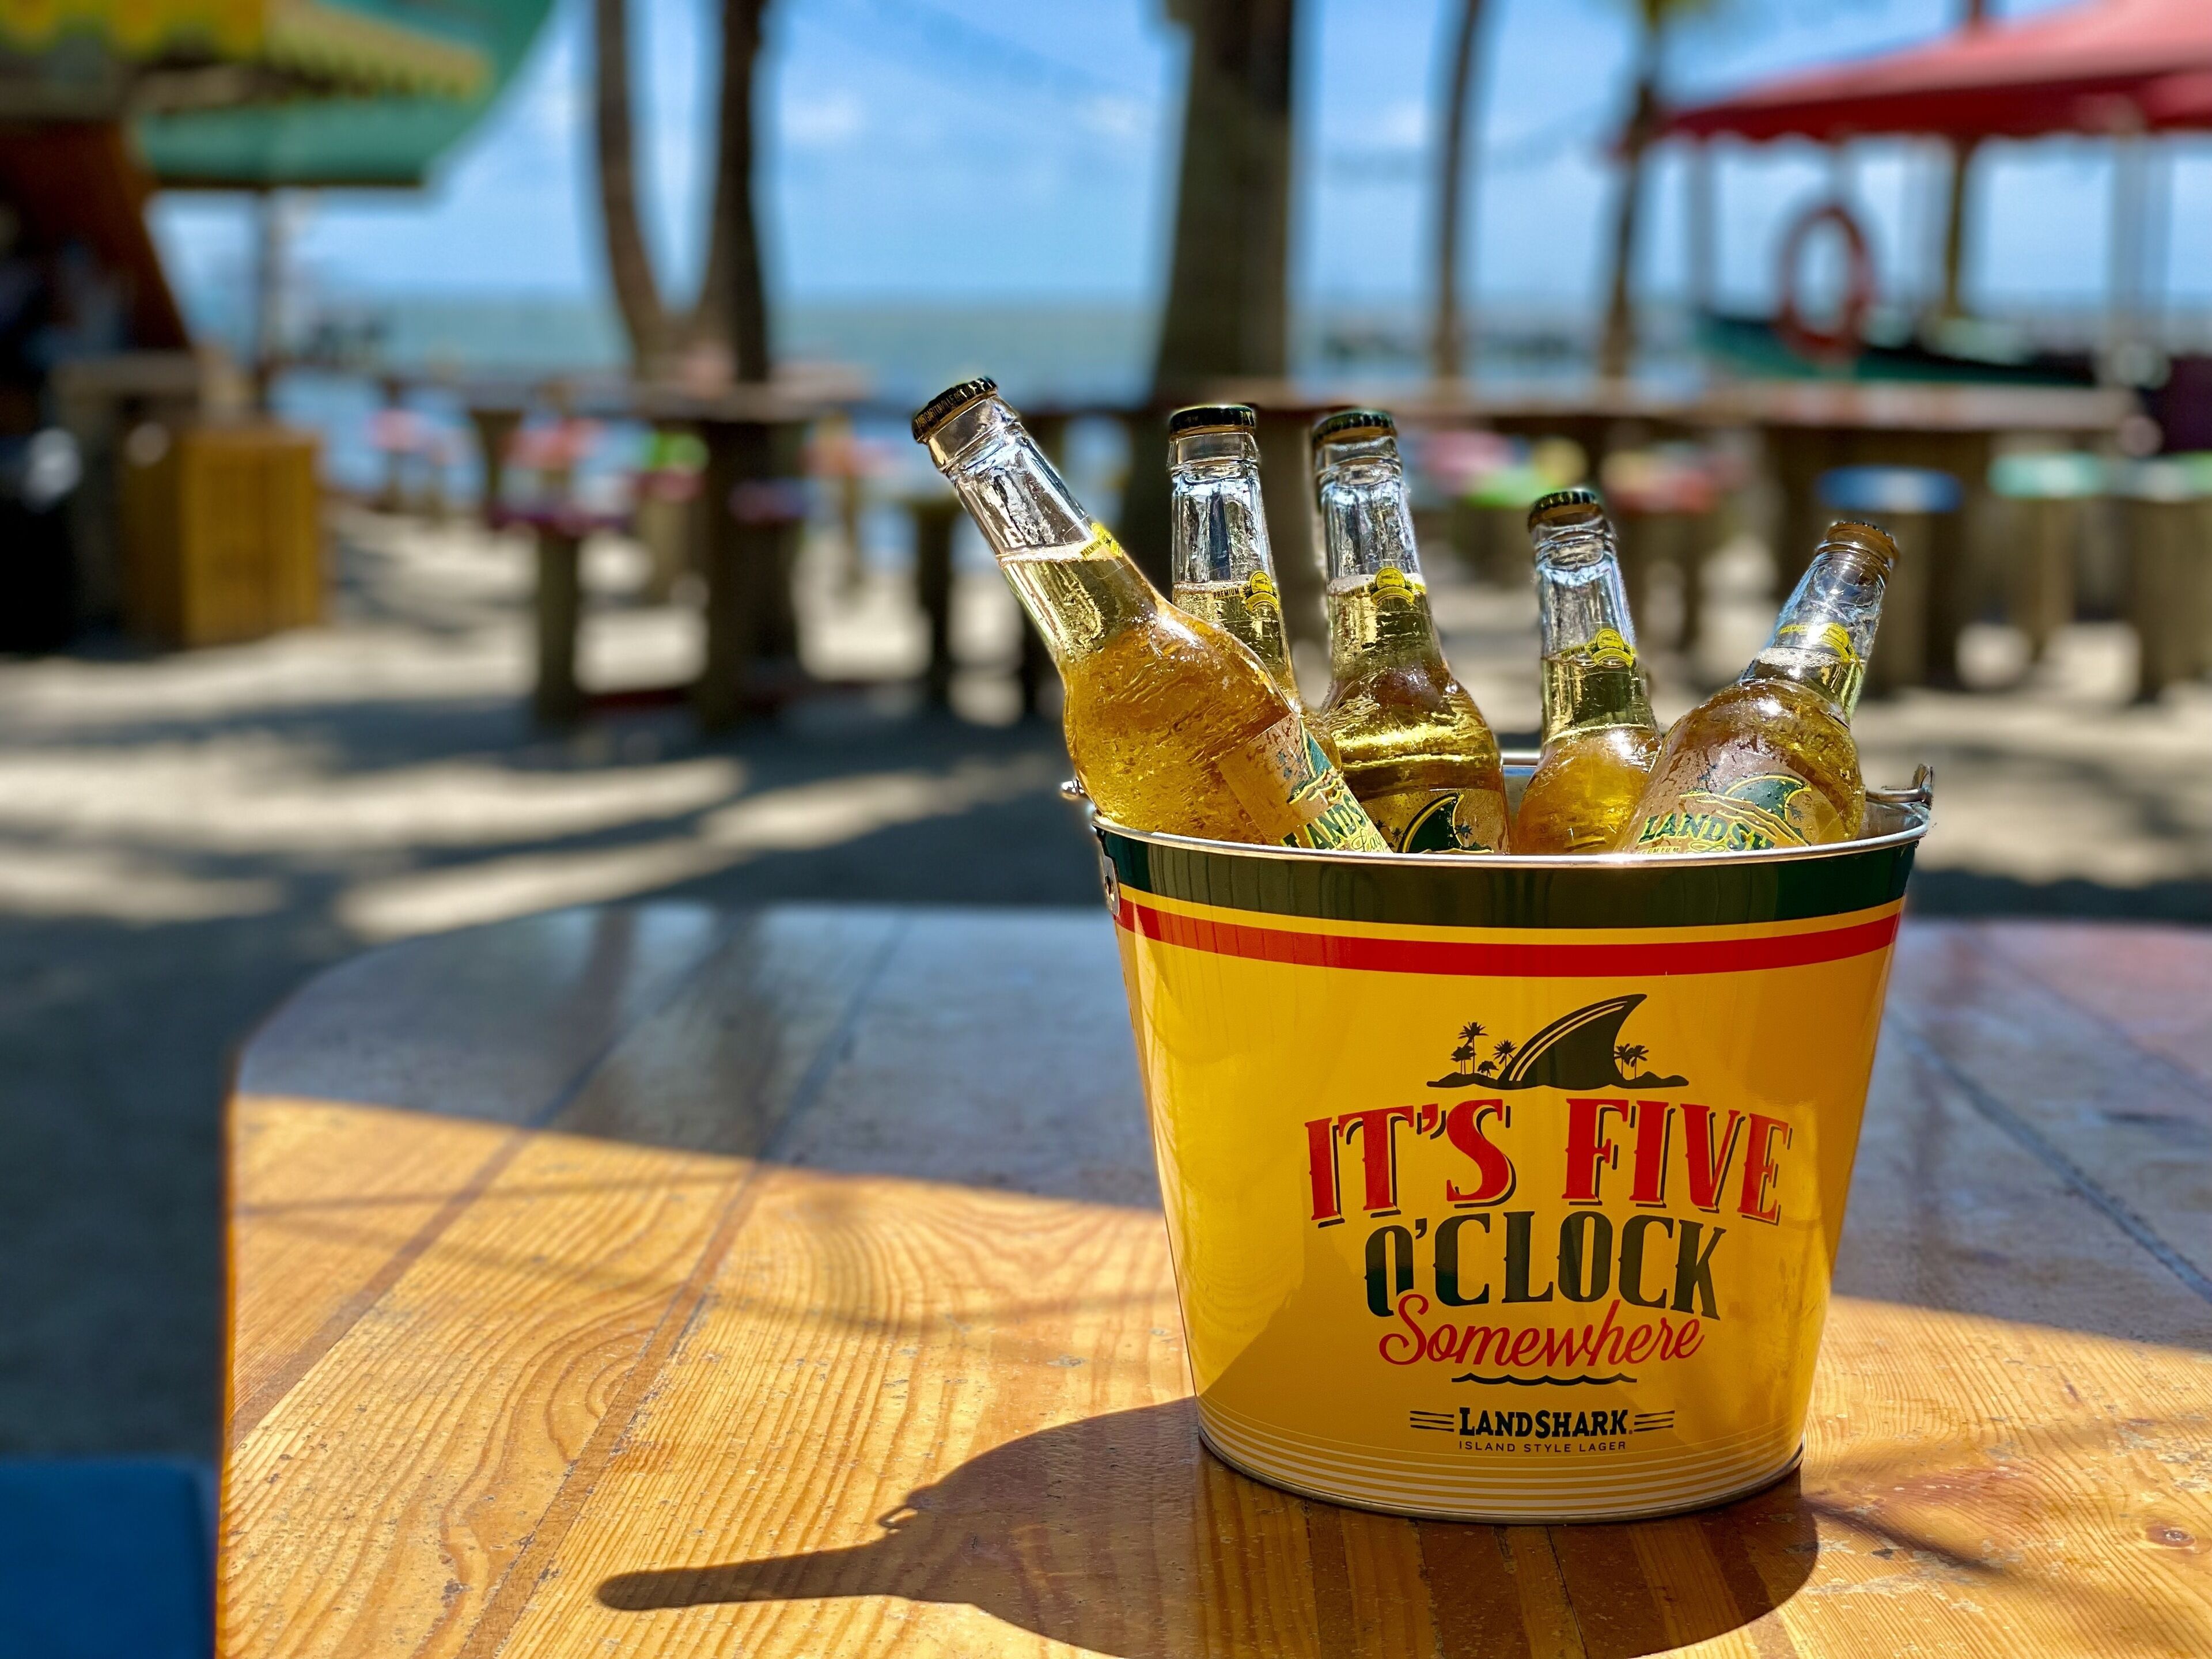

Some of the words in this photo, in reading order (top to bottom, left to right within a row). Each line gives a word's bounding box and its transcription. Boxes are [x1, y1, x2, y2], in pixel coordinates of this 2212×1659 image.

[1080, 539, 1103, 558] PREMIUM
[1213, 588, 1240, 599] PREMIUM
[1343, 586, 1365, 600] PREMIUM
[1561, 646, 1585, 658] PREMIUM
[1304, 1099, 1517, 1228] IT'S
[1561, 1097, 1793, 1226] FIVE
[1364, 1210, 1727, 1320] O'CLOCK
[1379, 1294, 1705, 1368] Somewhere
[1459, 1440, 1516, 1452] ISLAND
[1524, 1444, 1571, 1453] STYLE
[1579, 1441, 1626, 1452] LAGER
